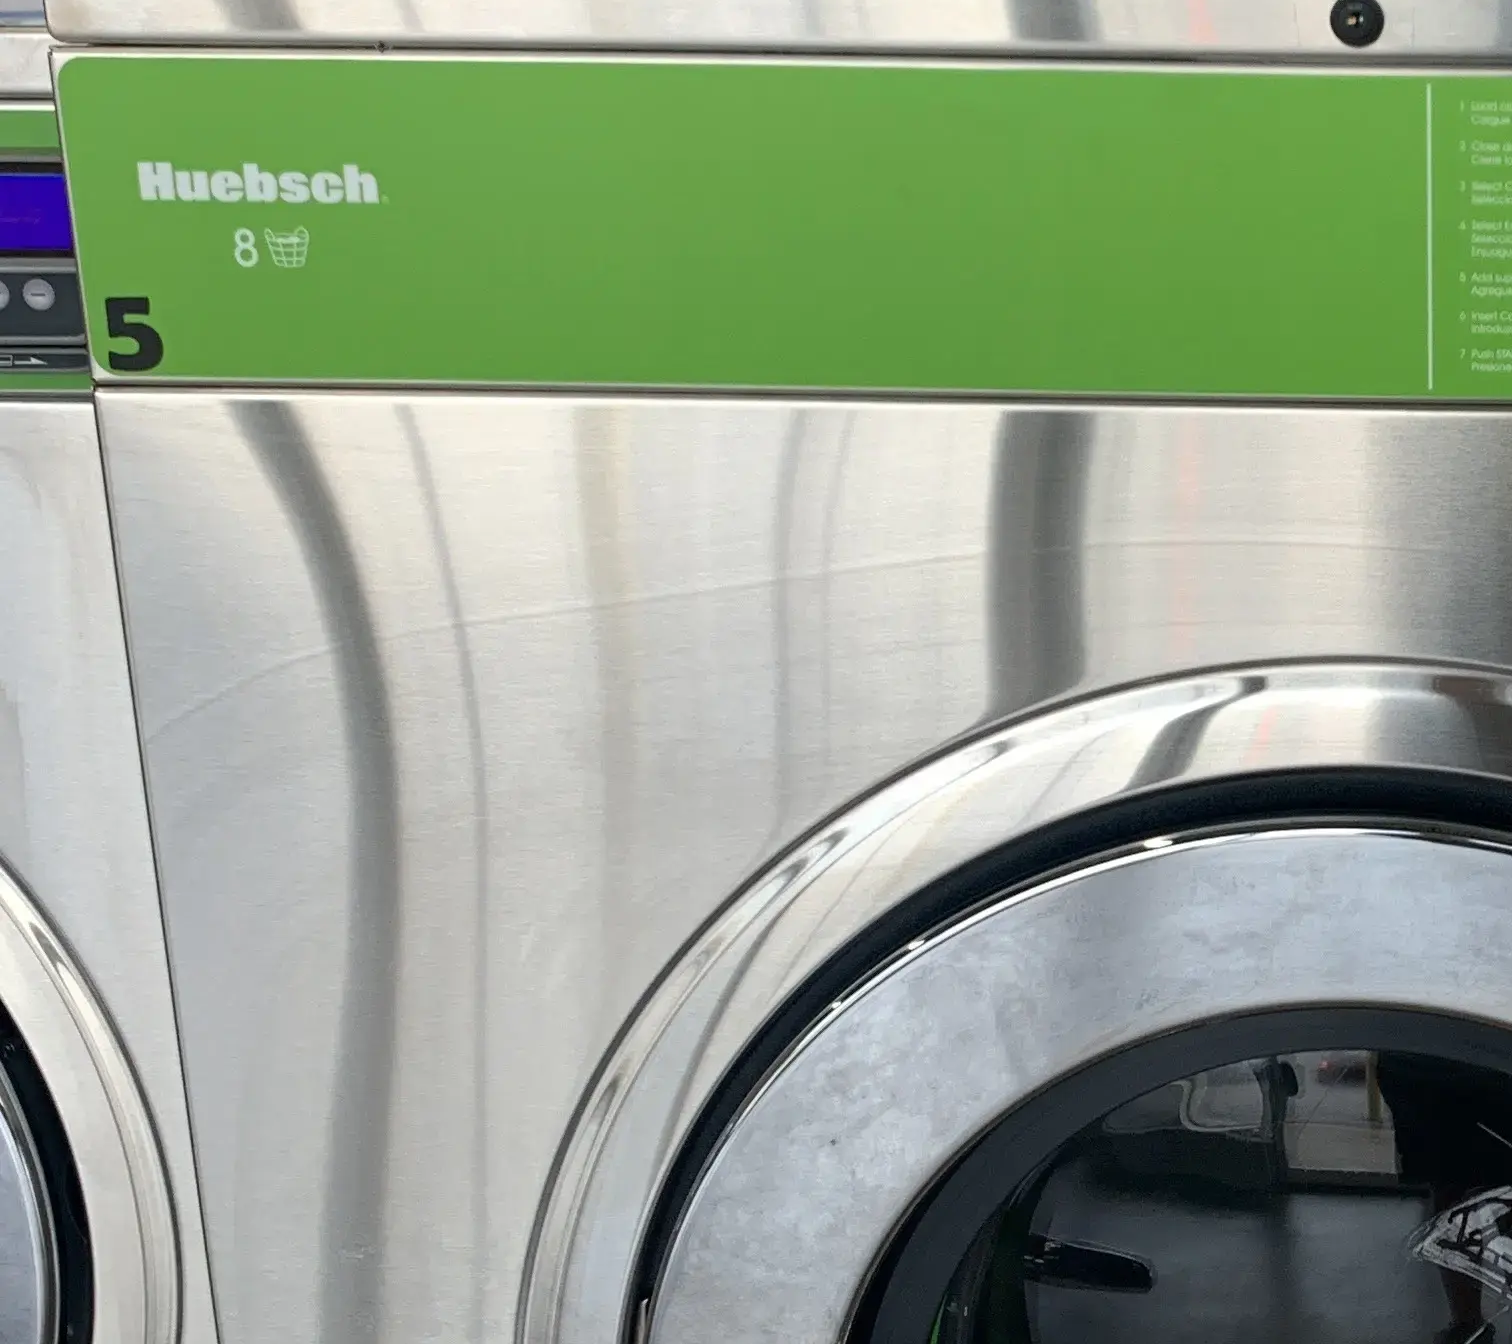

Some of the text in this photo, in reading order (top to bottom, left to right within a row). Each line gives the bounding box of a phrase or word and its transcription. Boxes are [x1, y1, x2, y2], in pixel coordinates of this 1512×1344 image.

[137, 161, 380, 204] Huebsch
[234, 227, 259, 268] 8
[105, 297, 164, 371] 5
